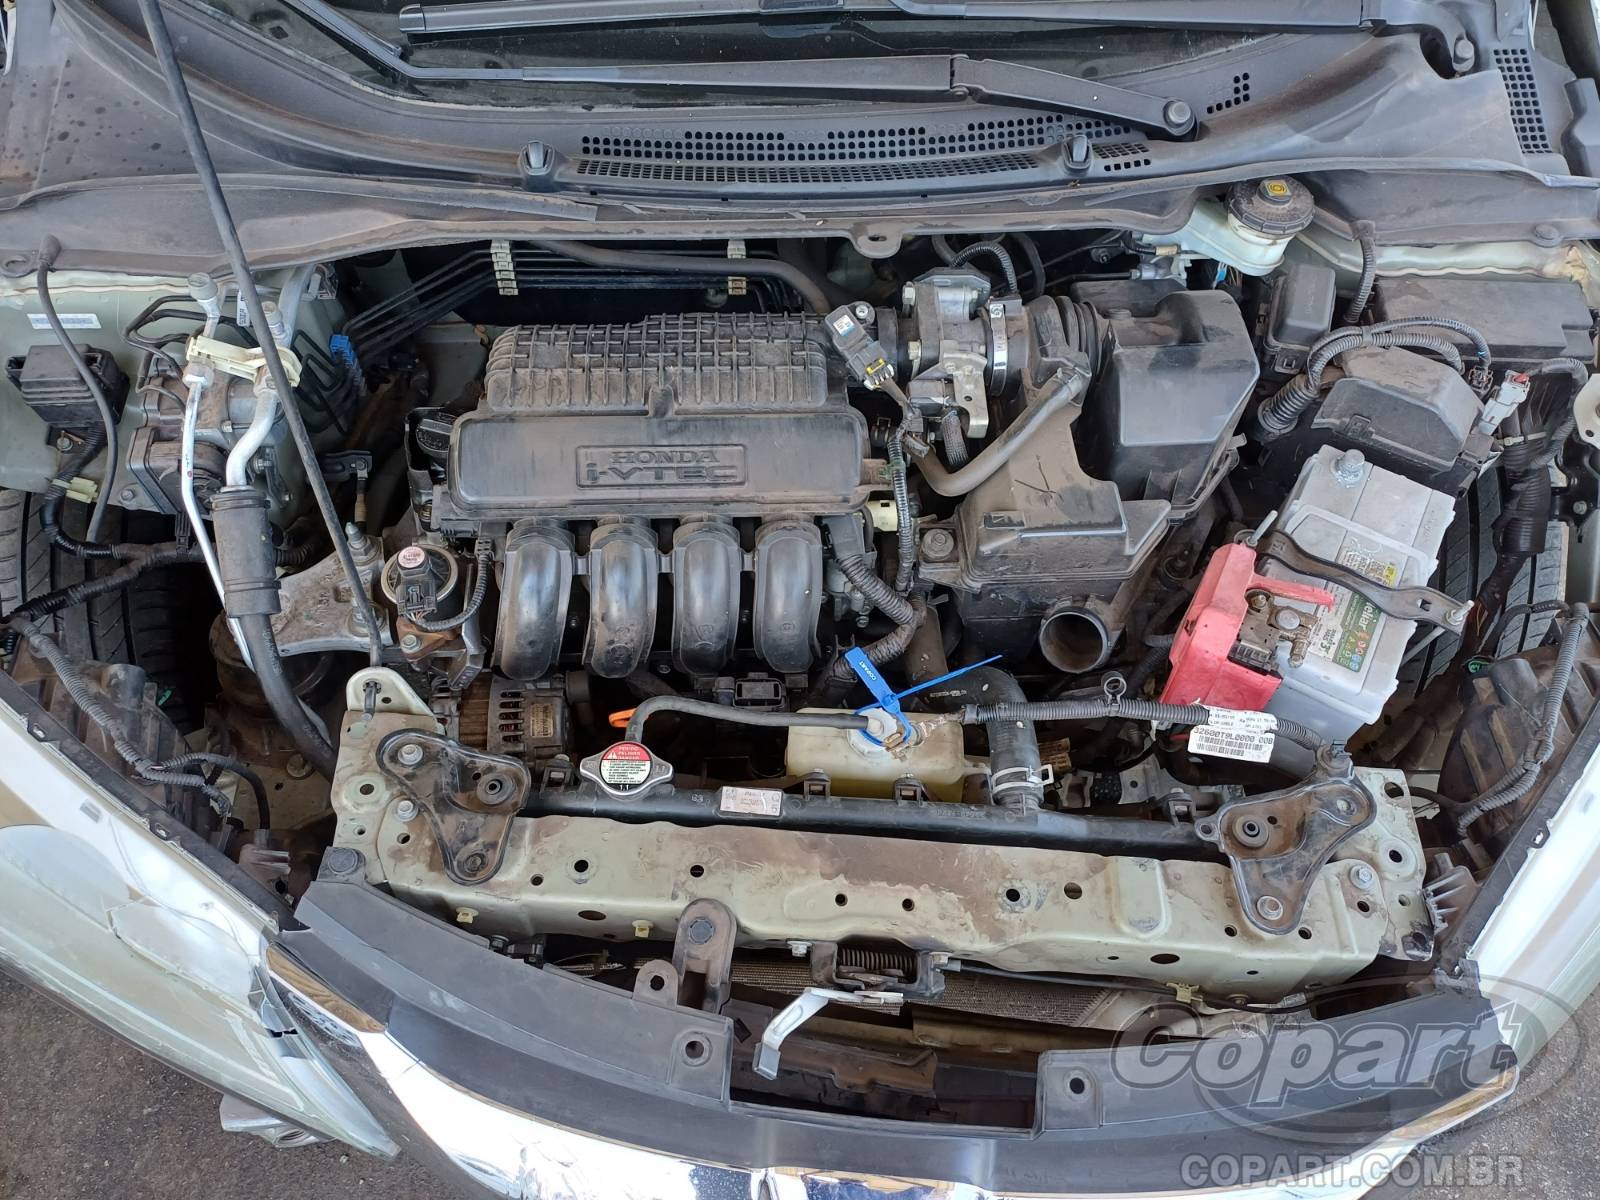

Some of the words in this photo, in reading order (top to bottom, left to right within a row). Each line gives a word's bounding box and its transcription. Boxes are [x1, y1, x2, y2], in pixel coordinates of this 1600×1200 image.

[610, 450, 721, 464] HONDA
[586, 463, 738, 482] i-VTEC
[859, 660, 877, 681] COPART
